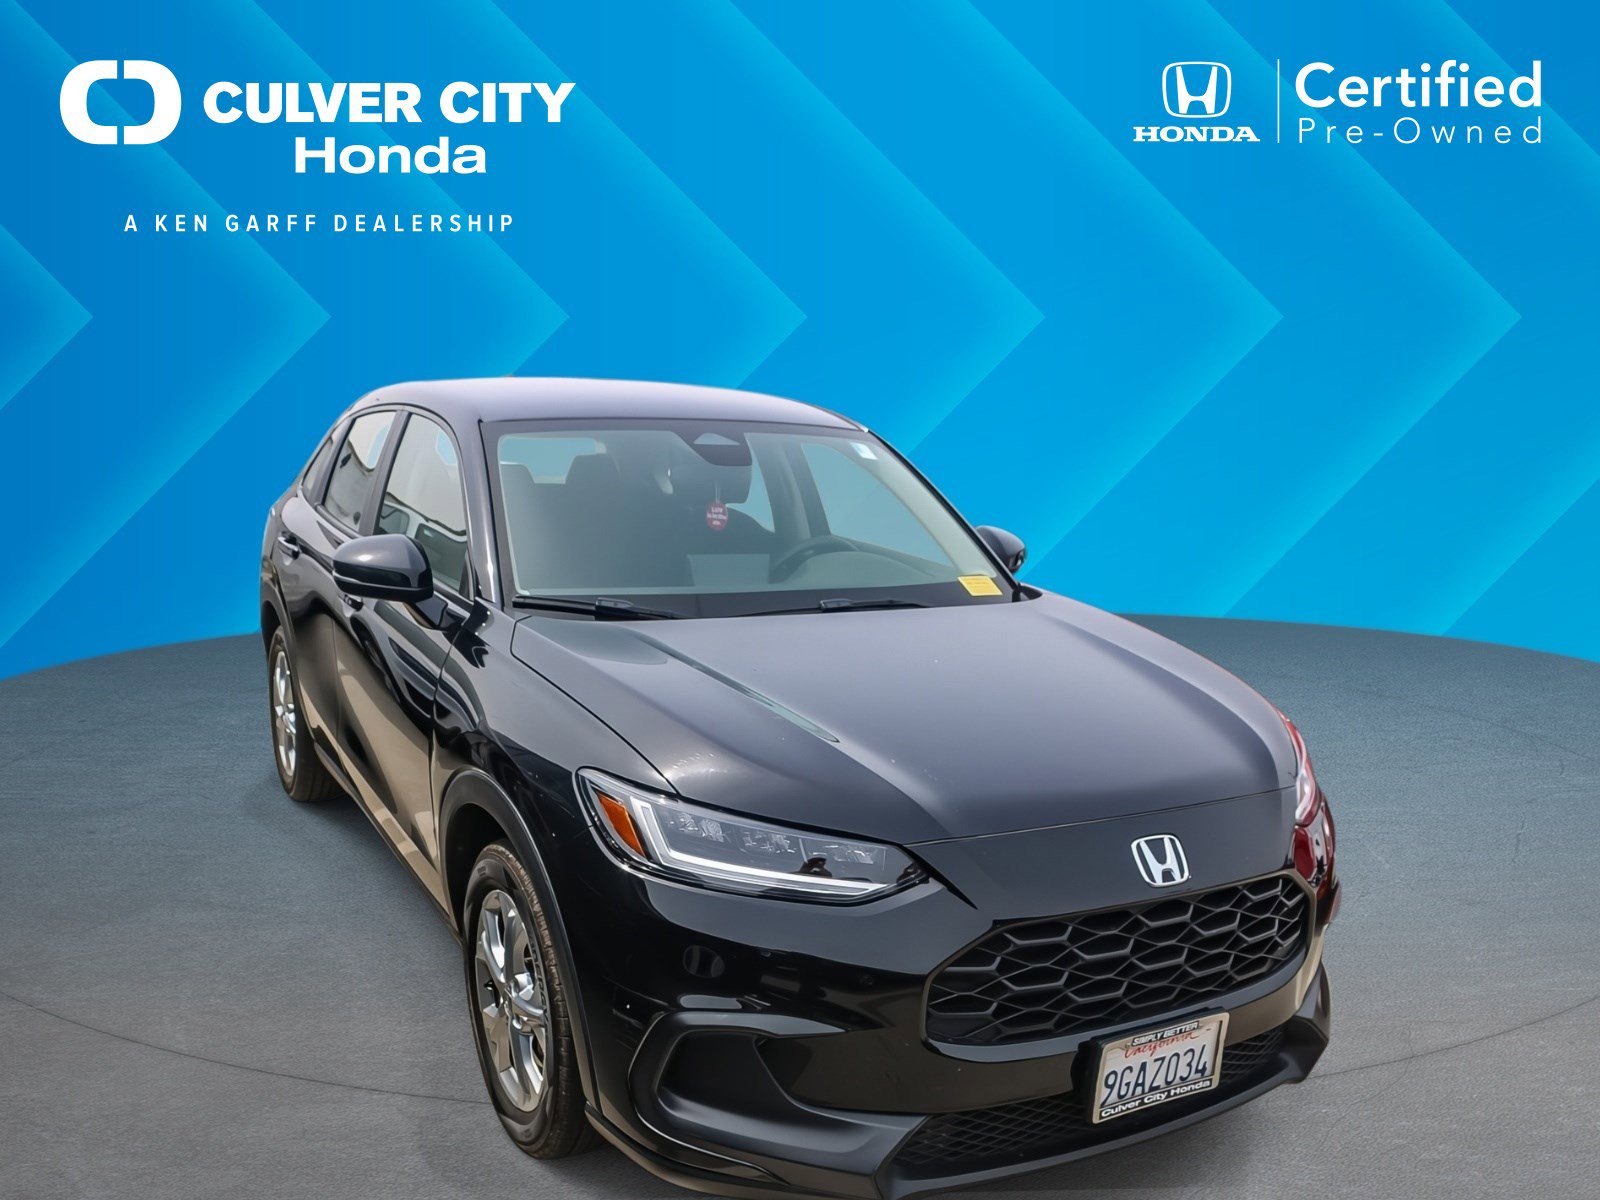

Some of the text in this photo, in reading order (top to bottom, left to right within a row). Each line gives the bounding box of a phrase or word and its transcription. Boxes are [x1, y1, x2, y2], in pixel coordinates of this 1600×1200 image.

[1132, 1022, 1199, 1046] SIMPLY BETTER
[1100, 1044, 1208, 1108] 9GAZ034
[1101, 1080, 1211, 1118] Culver City Honda
